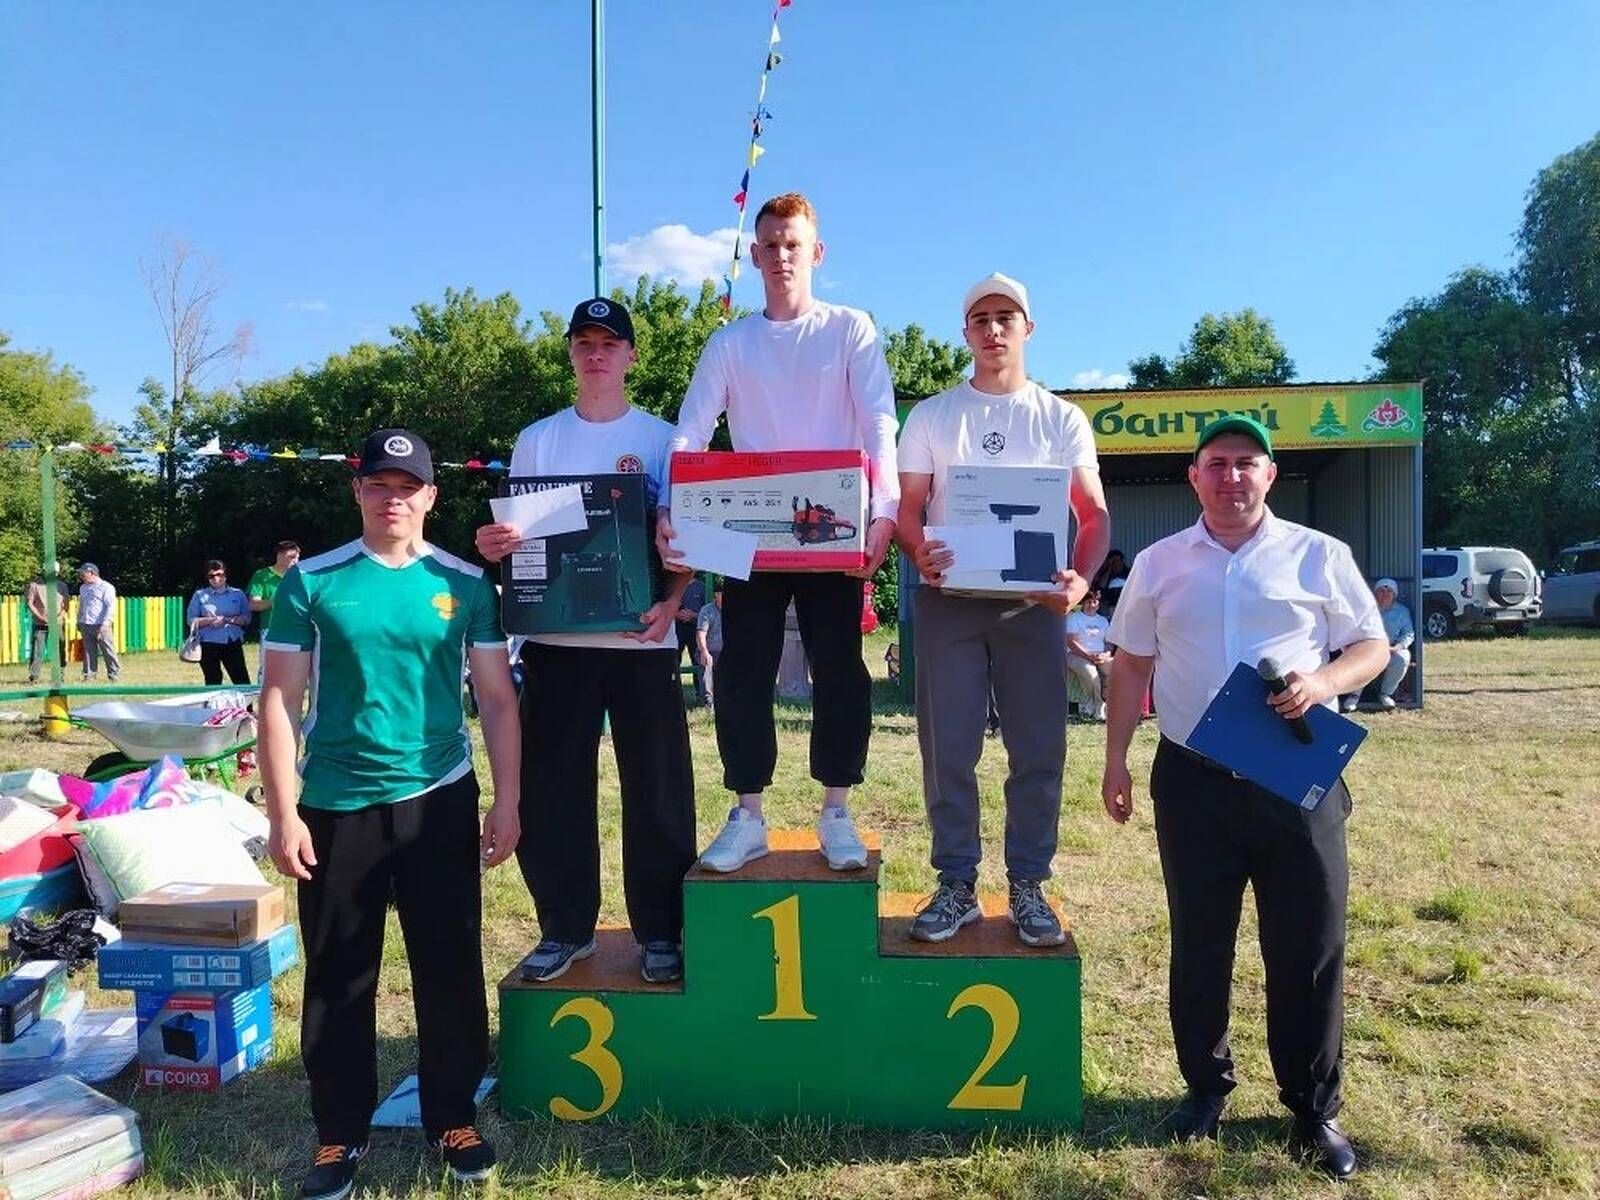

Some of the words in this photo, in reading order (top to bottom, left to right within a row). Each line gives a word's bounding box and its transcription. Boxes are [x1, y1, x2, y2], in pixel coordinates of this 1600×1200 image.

[752, 894, 818, 1020] 1
[164, 1070, 210, 1086] СОЮЗ
[549, 997, 625, 1122] 3
[946, 983, 1028, 1111] 2
